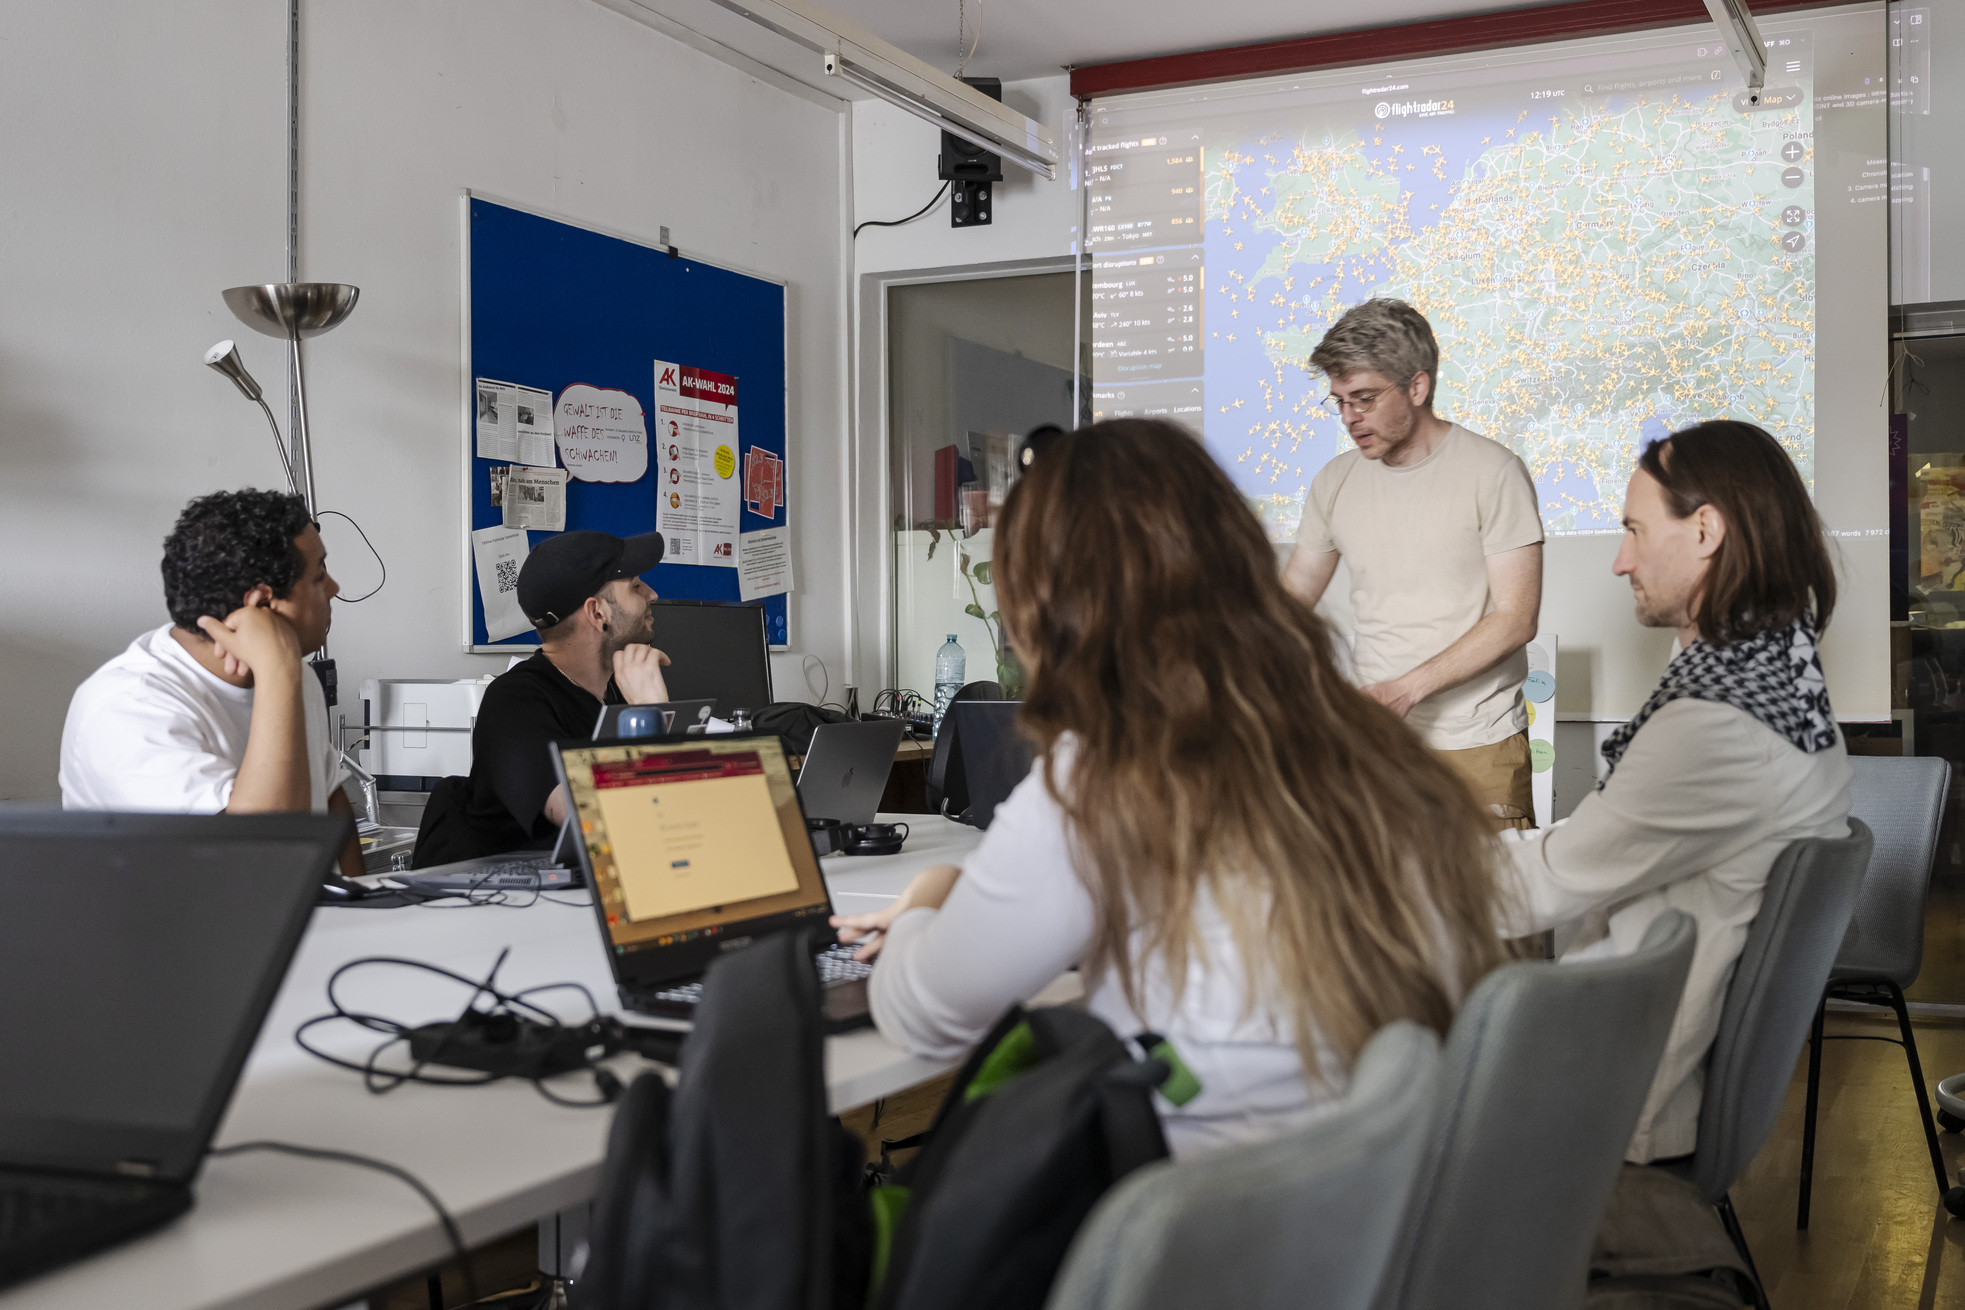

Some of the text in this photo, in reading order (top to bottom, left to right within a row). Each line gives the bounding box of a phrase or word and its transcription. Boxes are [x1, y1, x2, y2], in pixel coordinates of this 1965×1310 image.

[1362, 84, 1409, 95] flightradar24.com
[1598, 83, 1612, 91] Find
[1638, 79, 1665, 88] airports
[1530, 90, 1552, 99] 12:19
[1843, 91, 1866, 100] images
[1763, 95, 1783, 105] Map
[1391, 99, 1454, 117] flightradar24
[1697, 120, 1728, 128] Szczecin
[1763, 118, 1799, 128] Bydgoscz
[1097, 142, 1120, 151] tracked
[1120, 140, 1139, 150] flights
[1855, 183, 1879, 191] Camera
[1307, 207, 1341, 216] ENGLAND
[1103, 260, 1137, 268] disruptions
[1737, 272, 1754, 280] Brno
[1118, 350, 1142, 358] Variable
[1117, 364, 1147, 372] Disruption
[659, 367, 676, 387] AK
[682, 375, 735, 396] AK-WAHL 2024
[564, 403, 623, 420] GEWALT IST DIE
[1114, 409, 1134, 417] Flights
[1144, 407, 1168, 416] Airports
[1173, 405, 1202, 414] Locations
[564, 425, 589, 440] WAFFE
[591, 427, 605, 441] DES
[565, 447, 618, 464] SCHWACHEN!
[534, 478, 560, 487] Menschen
[713, 543, 723, 555] AK
